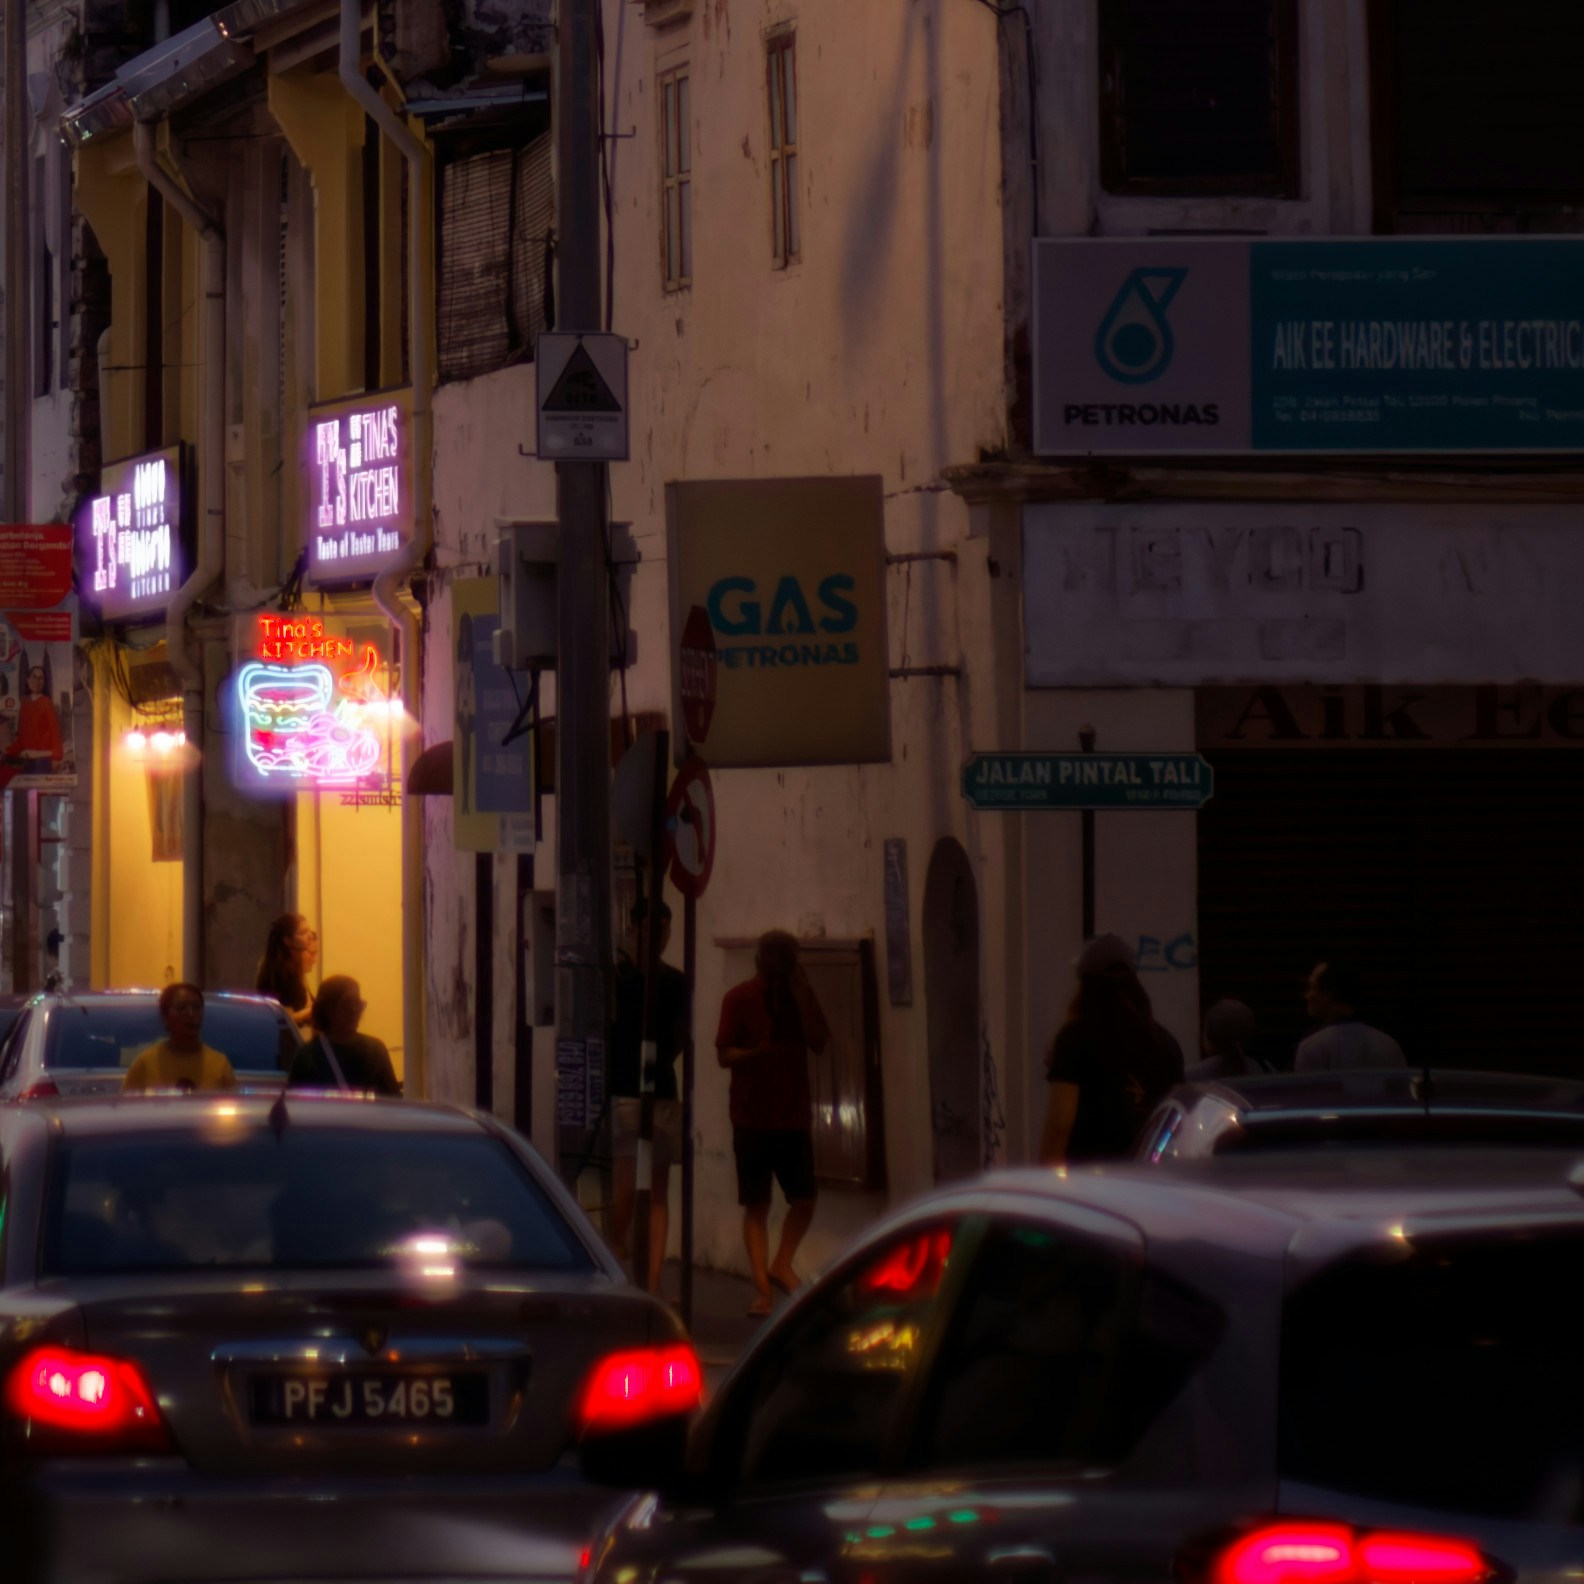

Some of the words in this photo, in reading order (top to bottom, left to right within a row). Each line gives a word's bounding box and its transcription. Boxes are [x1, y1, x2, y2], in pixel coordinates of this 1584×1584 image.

[1273, 320, 1307, 369] AIK
[1311, 320, 1335, 369] EE
[1340, 320, 1456, 369] HARDWARE
[1459, 320, 1472, 369] &
[1478, 320, 1584, 369] ELECTRIC
[1063, 402, 1220, 427] PETRONAS
[362, 405, 398, 462] TINA'S
[350, 465, 399, 522] KITCHEN
[317, 535, 338, 560] Taste
[707, 571, 859, 636] GAS
[260, 616, 323, 639] Tina's
[262, 640, 354, 659] KITCHEN
[715, 642, 860, 669] ETRONAS
[1224, 684, 1433, 740] Aik
[975, 761, 1051, 784] JALAN
[1059, 761, 1142, 784] PINTAL
[1149, 761, 1201, 784] TALI
[282, 1378, 356, 1419] PFJ
[363, 1378, 455, 1419] 5465
